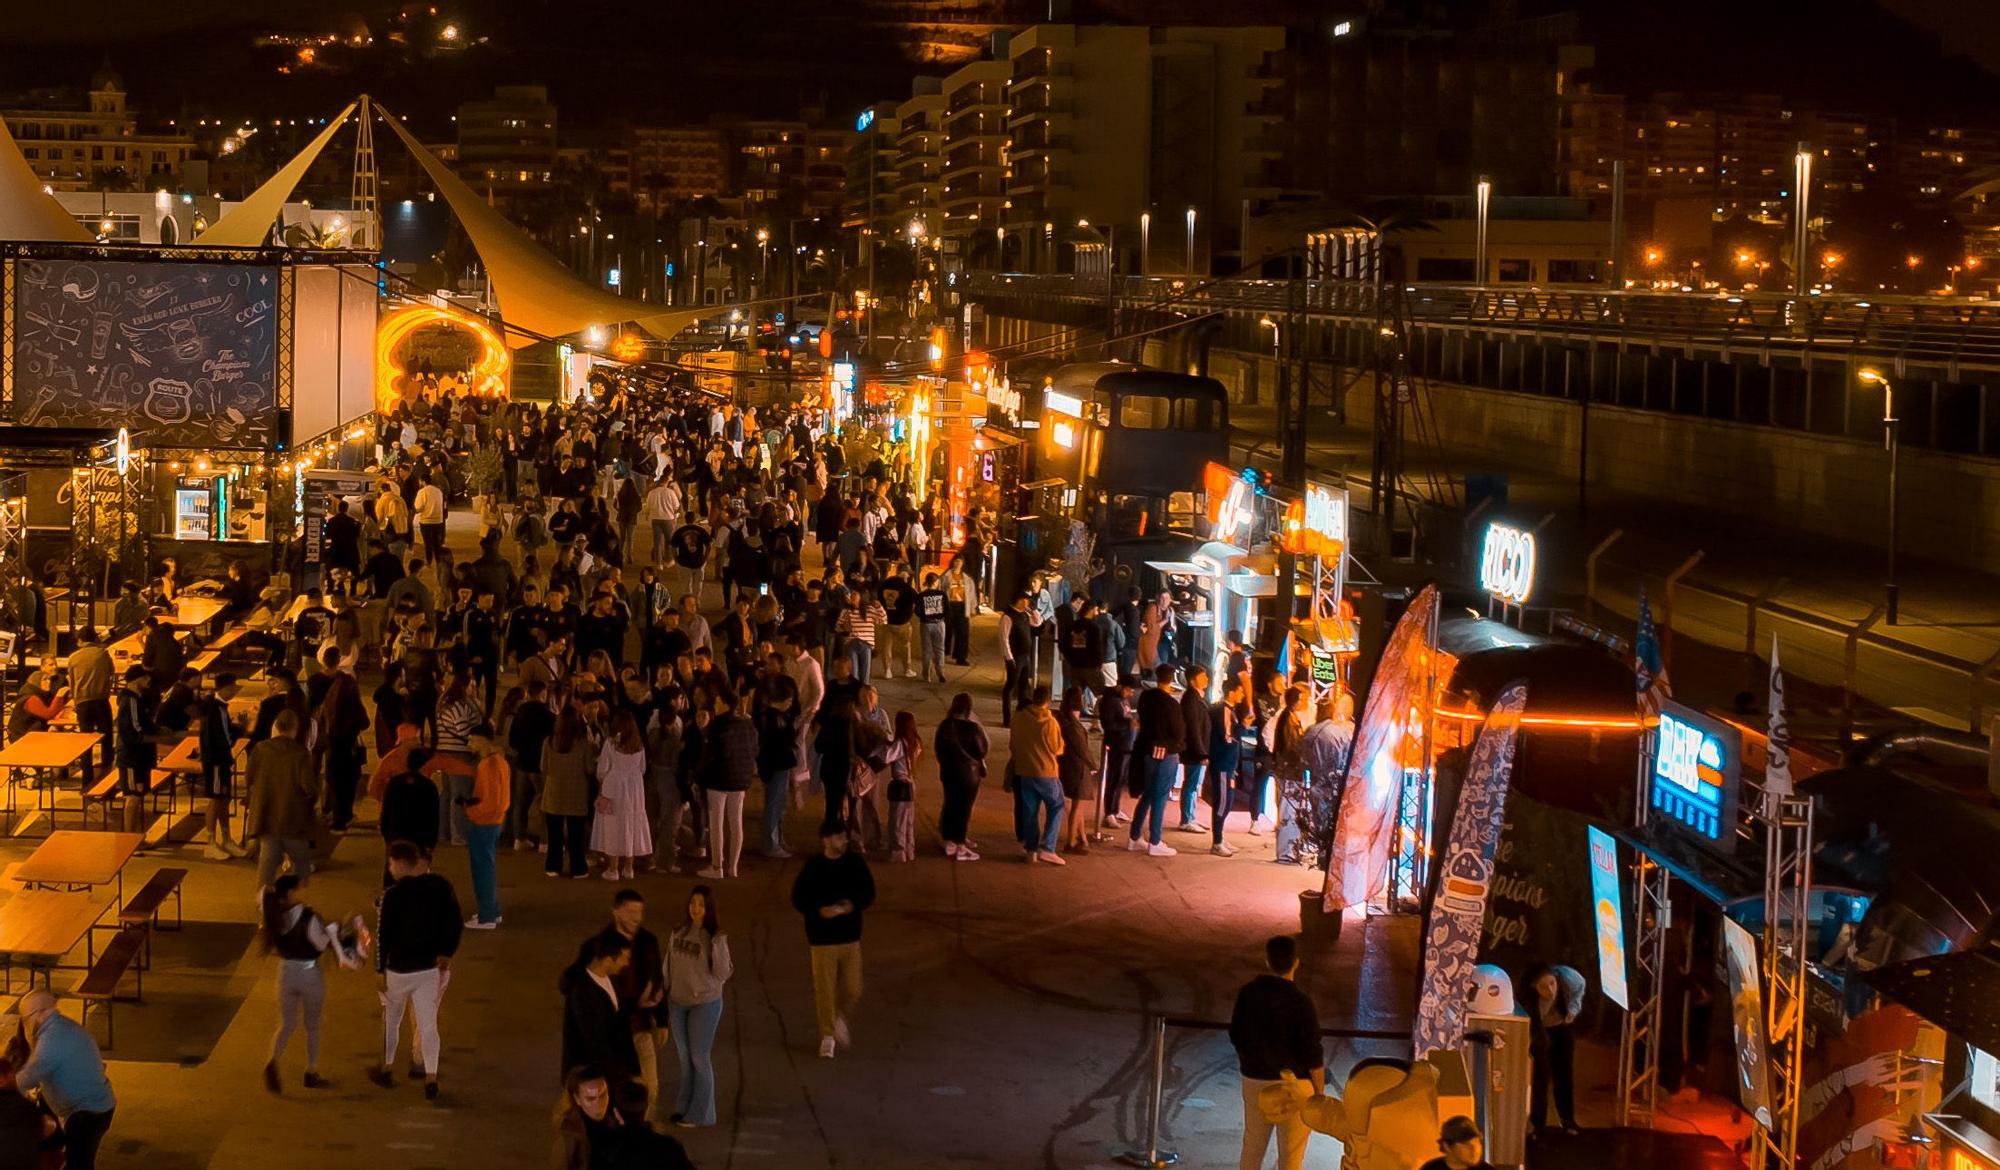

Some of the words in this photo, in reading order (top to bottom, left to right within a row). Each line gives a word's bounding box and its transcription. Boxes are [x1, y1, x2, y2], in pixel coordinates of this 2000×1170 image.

[235, 299, 272, 323] COOL
[217, 349, 235, 363] The
[201, 359, 251, 373] Champions
[211, 370, 244, 383] Burger
[157, 384, 184, 394] ROUTE
[94, 466, 121, 487] The
[1481, 523, 1536, 603] RICO
[1312, 657, 1334, 670] Uber
[1313, 668, 1336, 681] Eats
[1492, 872, 1545, 909] pions
